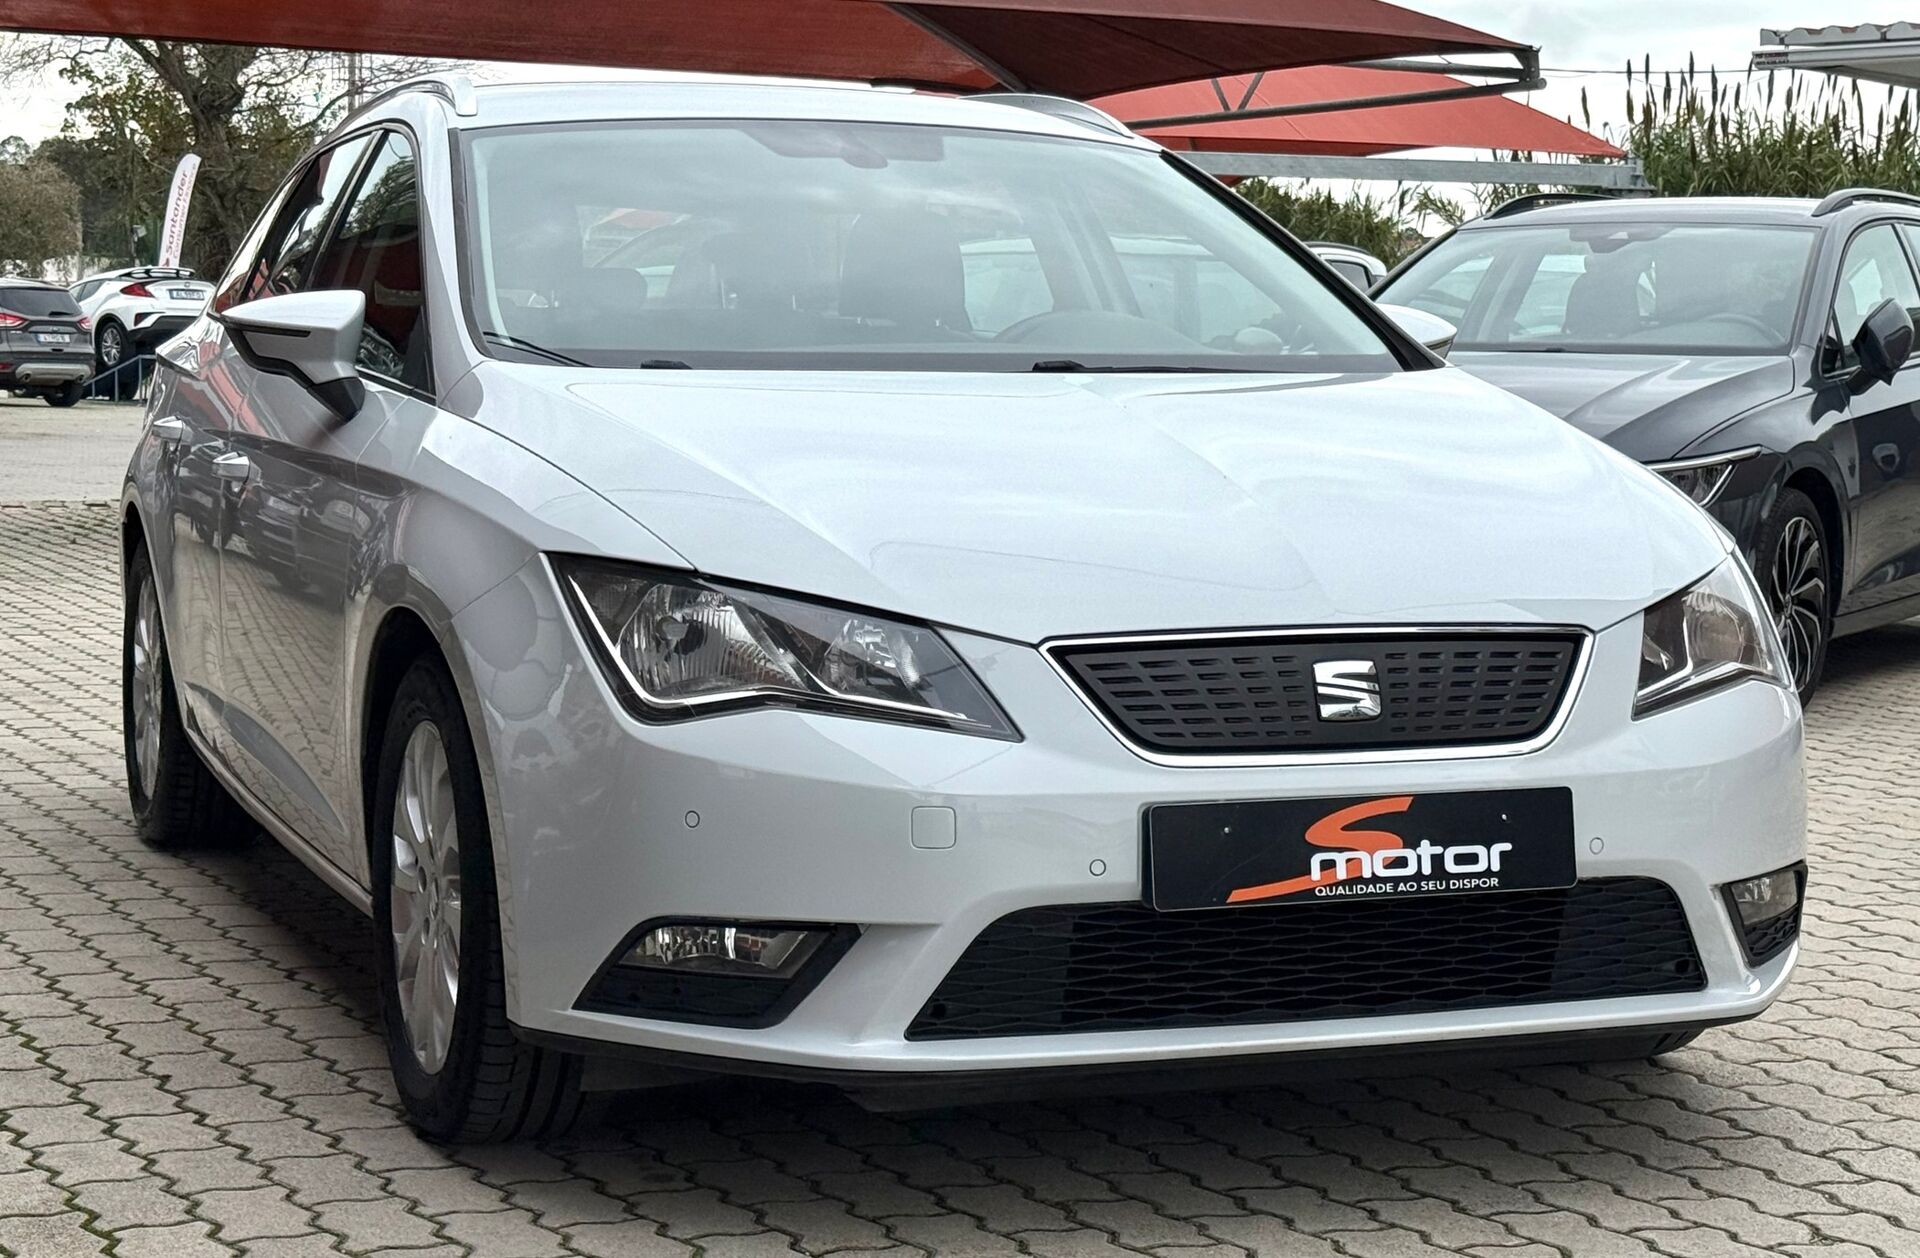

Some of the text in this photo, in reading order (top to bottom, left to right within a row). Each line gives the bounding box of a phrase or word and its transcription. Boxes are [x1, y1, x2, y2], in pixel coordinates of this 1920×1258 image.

[166, 169, 188, 256] Santander
[1314, 876, 1500, 897] QUALIDADE AO SEU DISPOR
